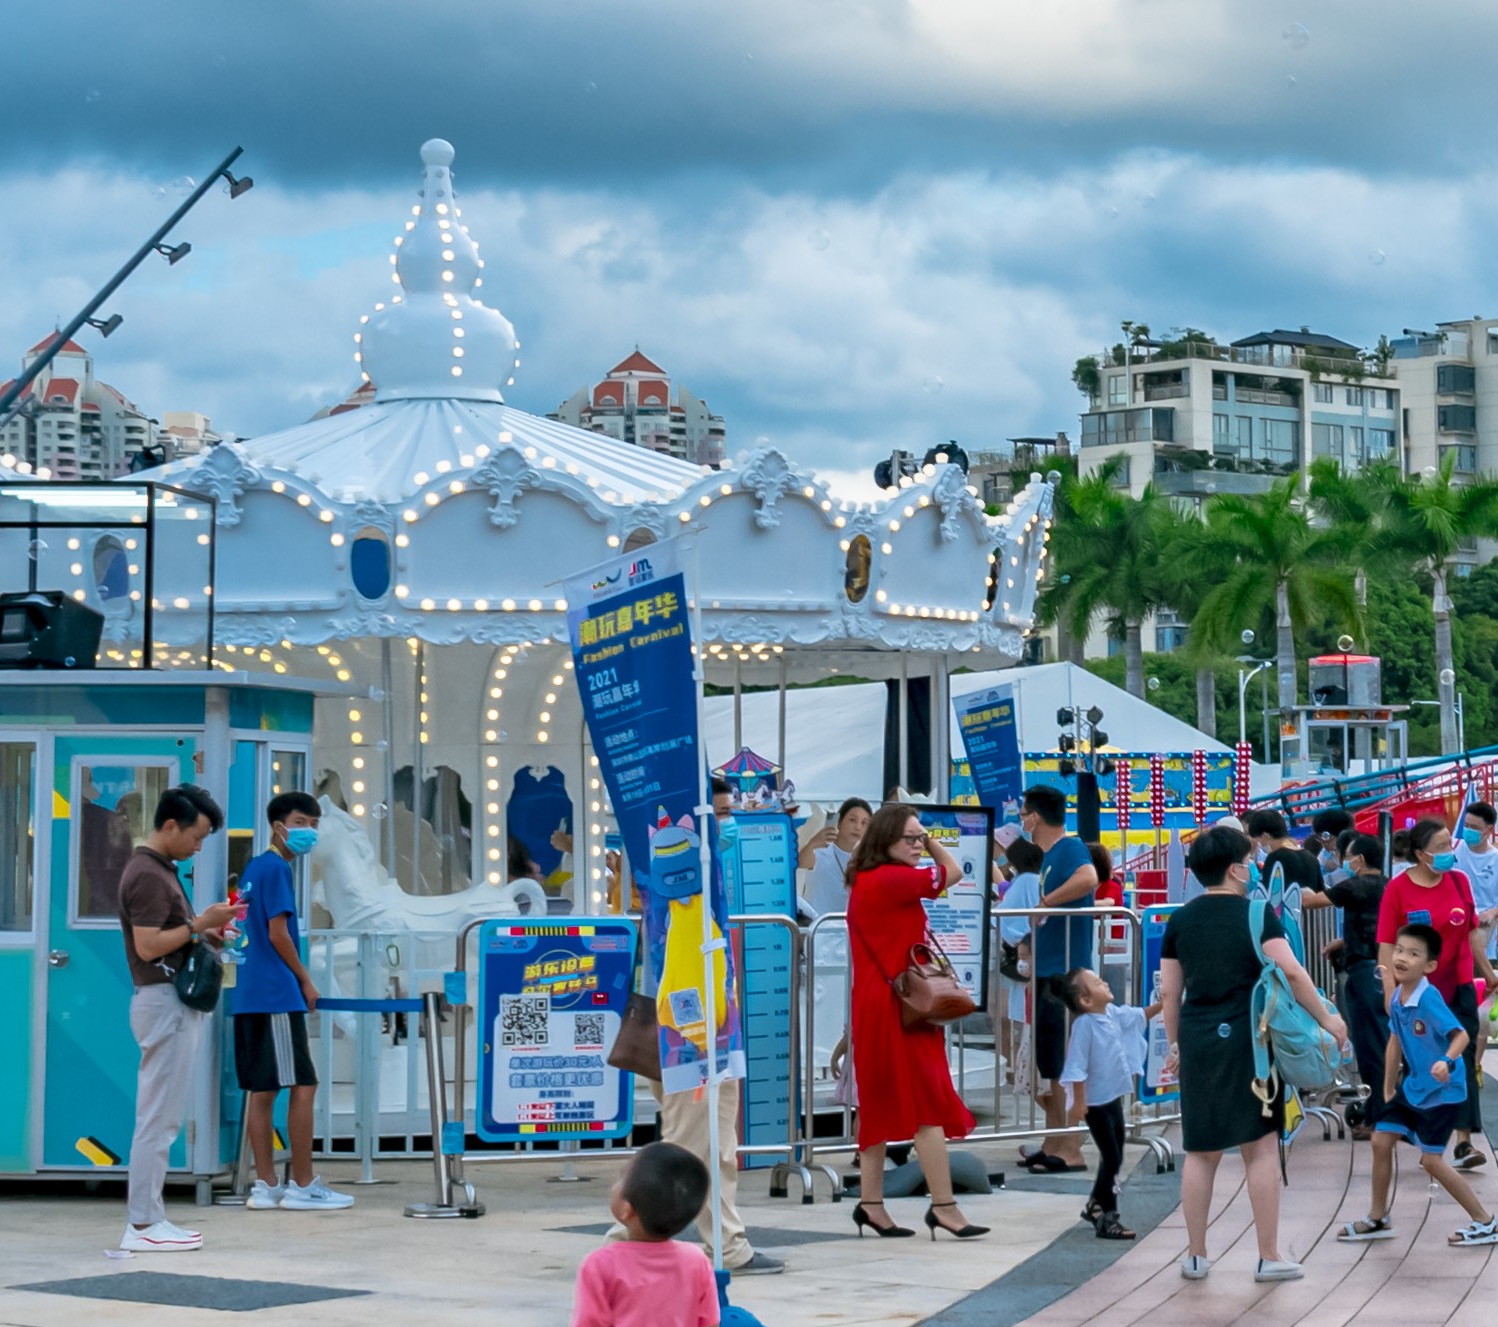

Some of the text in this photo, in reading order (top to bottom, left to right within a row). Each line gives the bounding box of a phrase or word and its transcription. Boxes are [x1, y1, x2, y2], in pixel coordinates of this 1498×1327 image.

[579, 592, 679, 647] 潮玩嘉年华
[629, 623, 684, 649] Carnival
[587, 667, 618, 691] 2021
